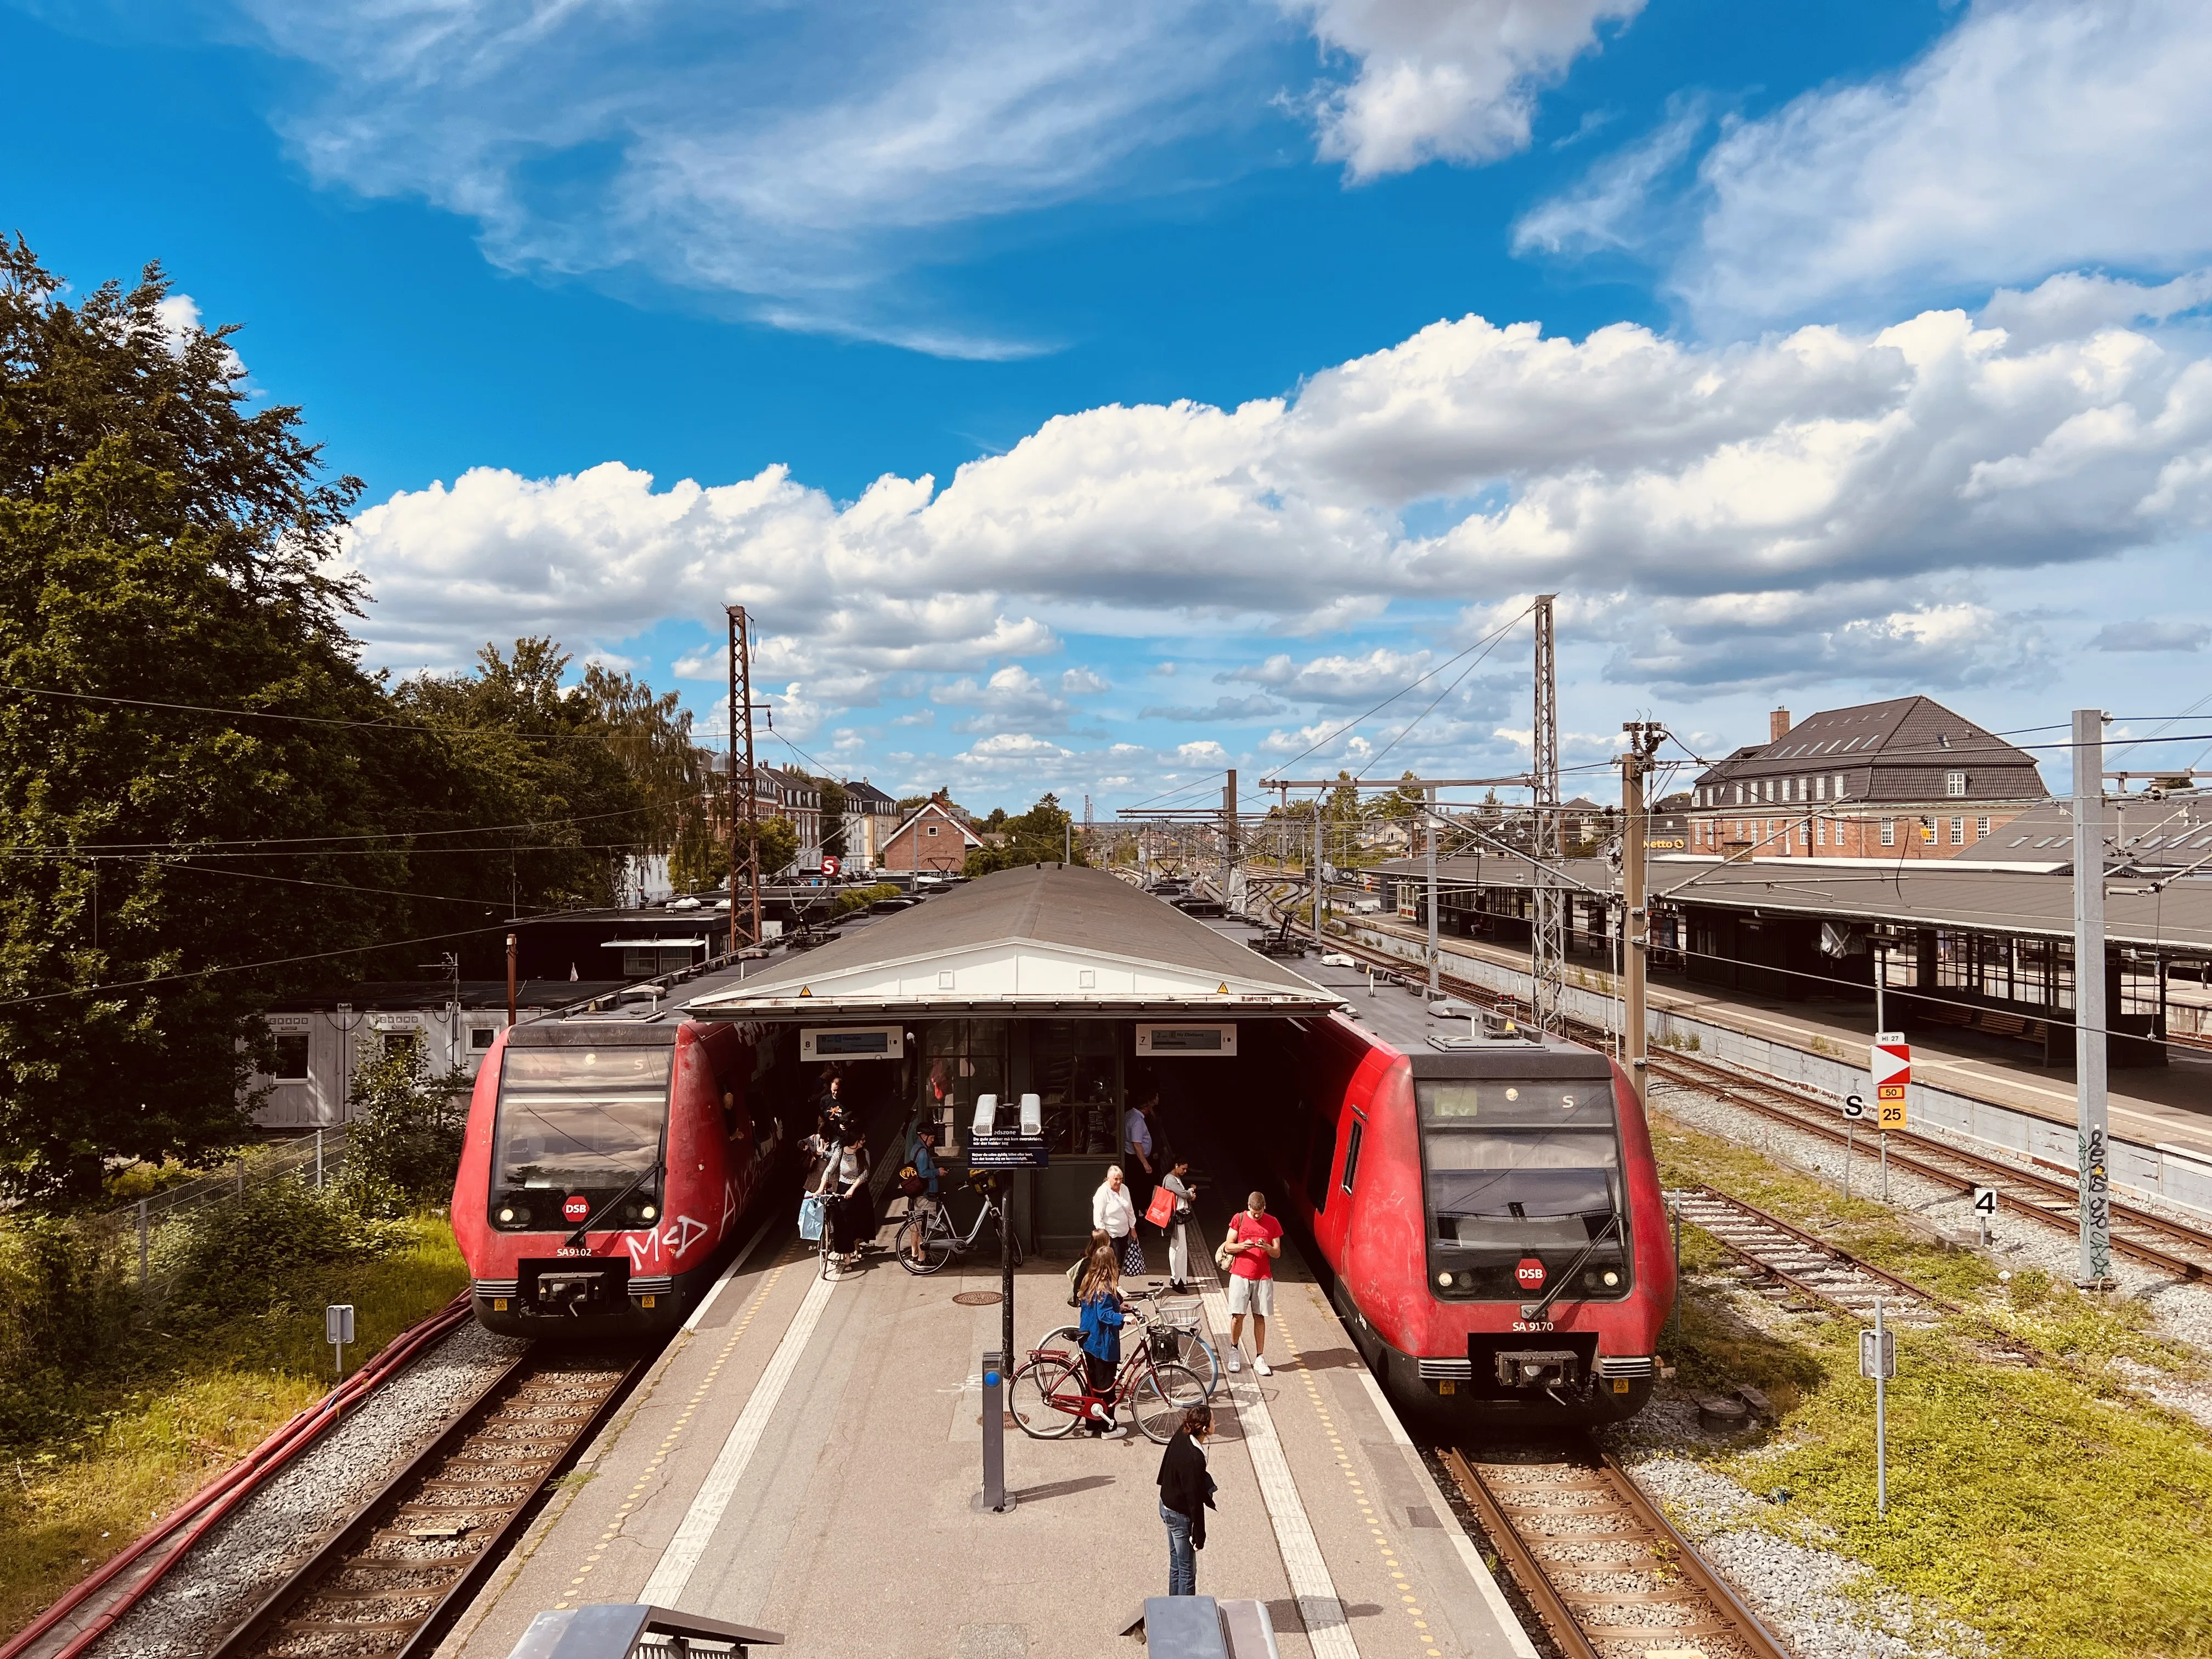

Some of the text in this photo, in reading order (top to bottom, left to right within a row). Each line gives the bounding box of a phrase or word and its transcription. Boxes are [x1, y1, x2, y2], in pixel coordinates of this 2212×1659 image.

[1643, 840, 1673, 848] Netto
[824, 860, 834, 874] S
[634, 1059, 644, 1070] S
[1562, 1096, 1574, 1108] S
[1845, 1096, 1863, 1116] S
[1883, 1108, 1901, 1121] 25
[1975, 1192, 1995, 1214] 4
[566, 1204, 586, 1214] DSB
[557, 1248, 592, 1257] SA9102
[1519, 1268, 1543, 1279] DSB
[1512, 1322, 1554, 1331] SA 9170
